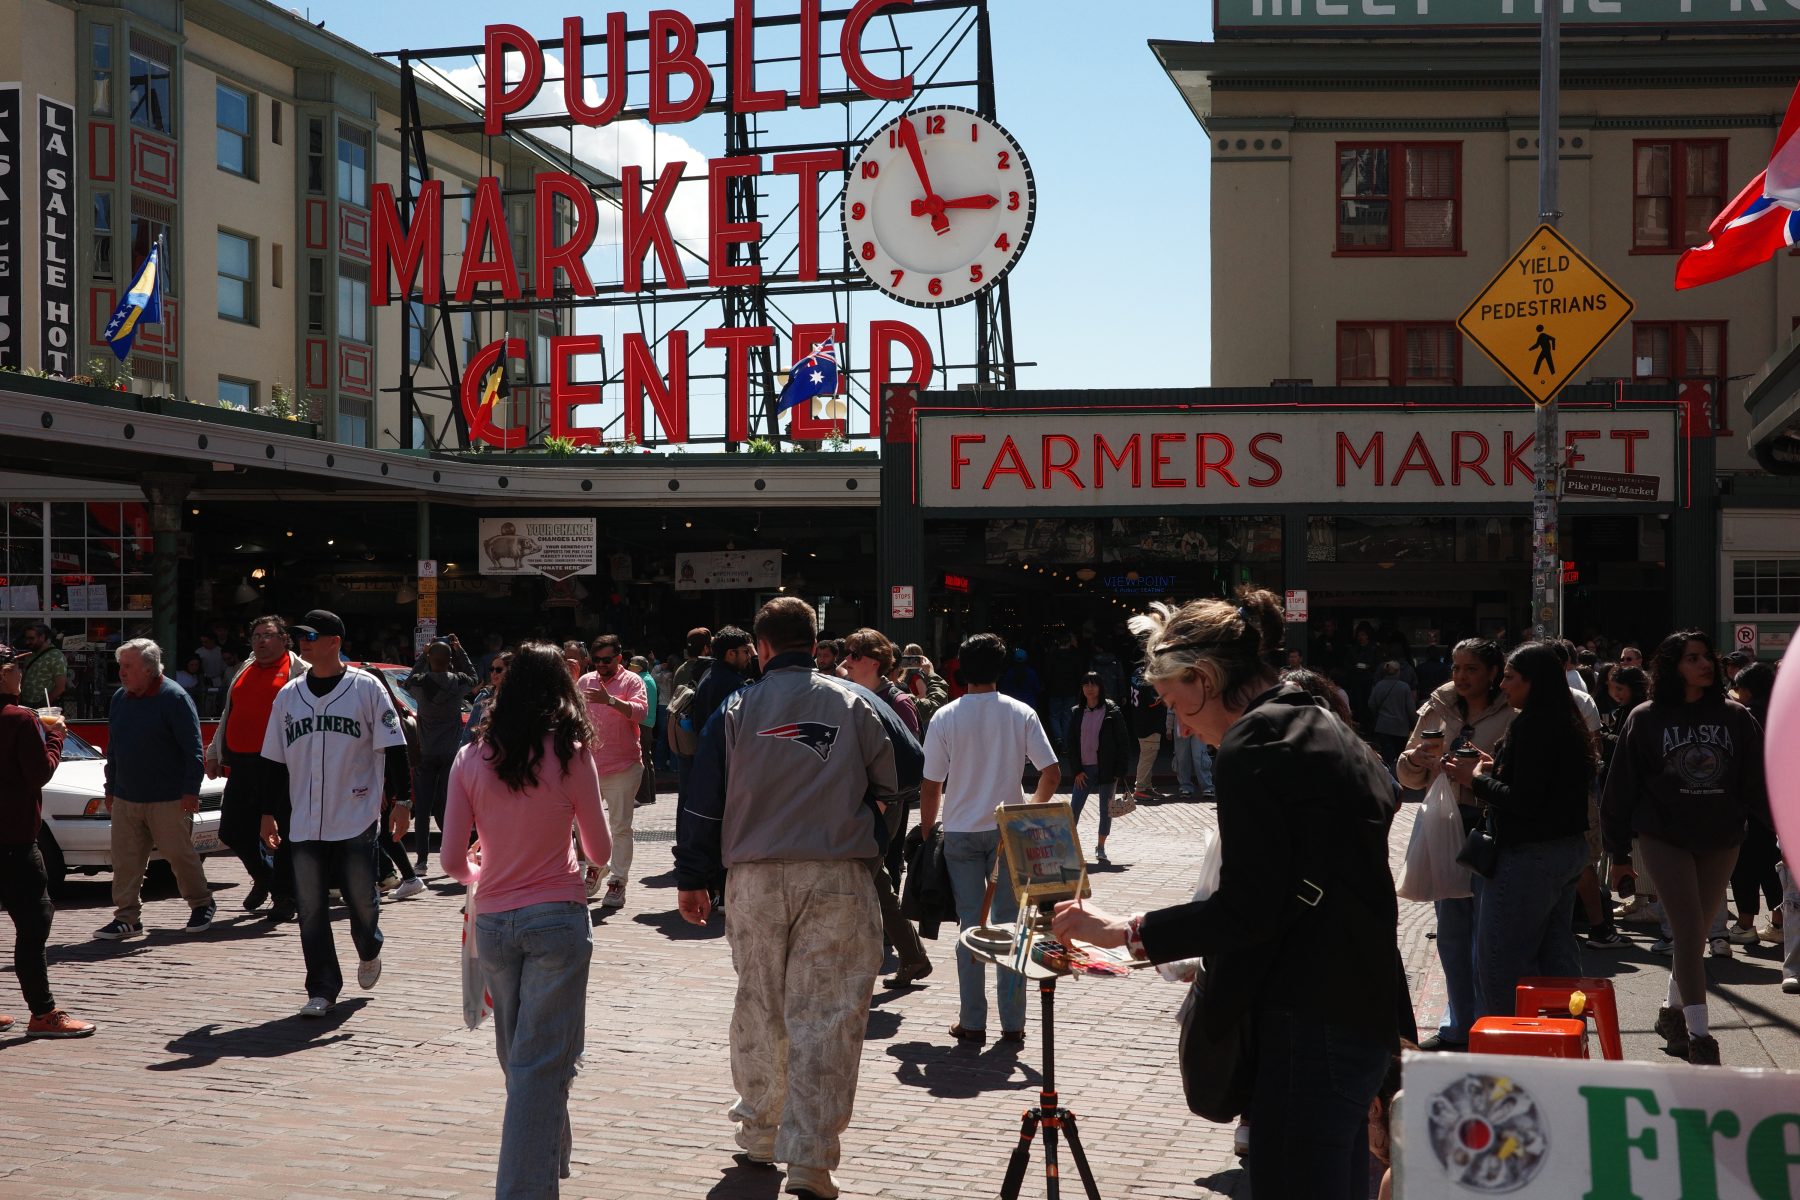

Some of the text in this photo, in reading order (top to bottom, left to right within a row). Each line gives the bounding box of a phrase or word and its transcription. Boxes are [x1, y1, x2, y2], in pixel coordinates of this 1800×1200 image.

[485, 0, 914, 136] PUBLIC
[45, 105, 68, 157] LA
[926, 115, 945, 134] 12
[971, 123, 978, 142] 1
[861, 160, 879, 180] 10
[997, 151, 1010, 170] 2
[1006, 191, 1020, 211] 3
[851, 202, 866, 221] 9
[45, 168, 68, 289] SALLE
[369, 150, 844, 306] MARKET
[861, 241, 876, 261] 8
[994, 233, 1010, 251] 4
[969, 264, 984, 283] 5
[1518, 255, 1570, 276] YIELD
[890, 269, 904, 287] 7
[927, 278, 943, 296] 6
[1532, 277, 1554, 295] TO
[1481, 293, 1607, 321] PEDESTRIANS
[460, 319, 933, 448] CENTER
[950, 429, 1650, 490] FARMERS MARKET
[1567, 481, 1656, 496] Pike Place Market
[526, 523, 594, 536] YOUR CHANGE
[1103, 575, 1177, 587] VIEWPOINT
[285, 714, 361, 748] MARINERS
[1662, 724, 1734, 758] ALASKA
